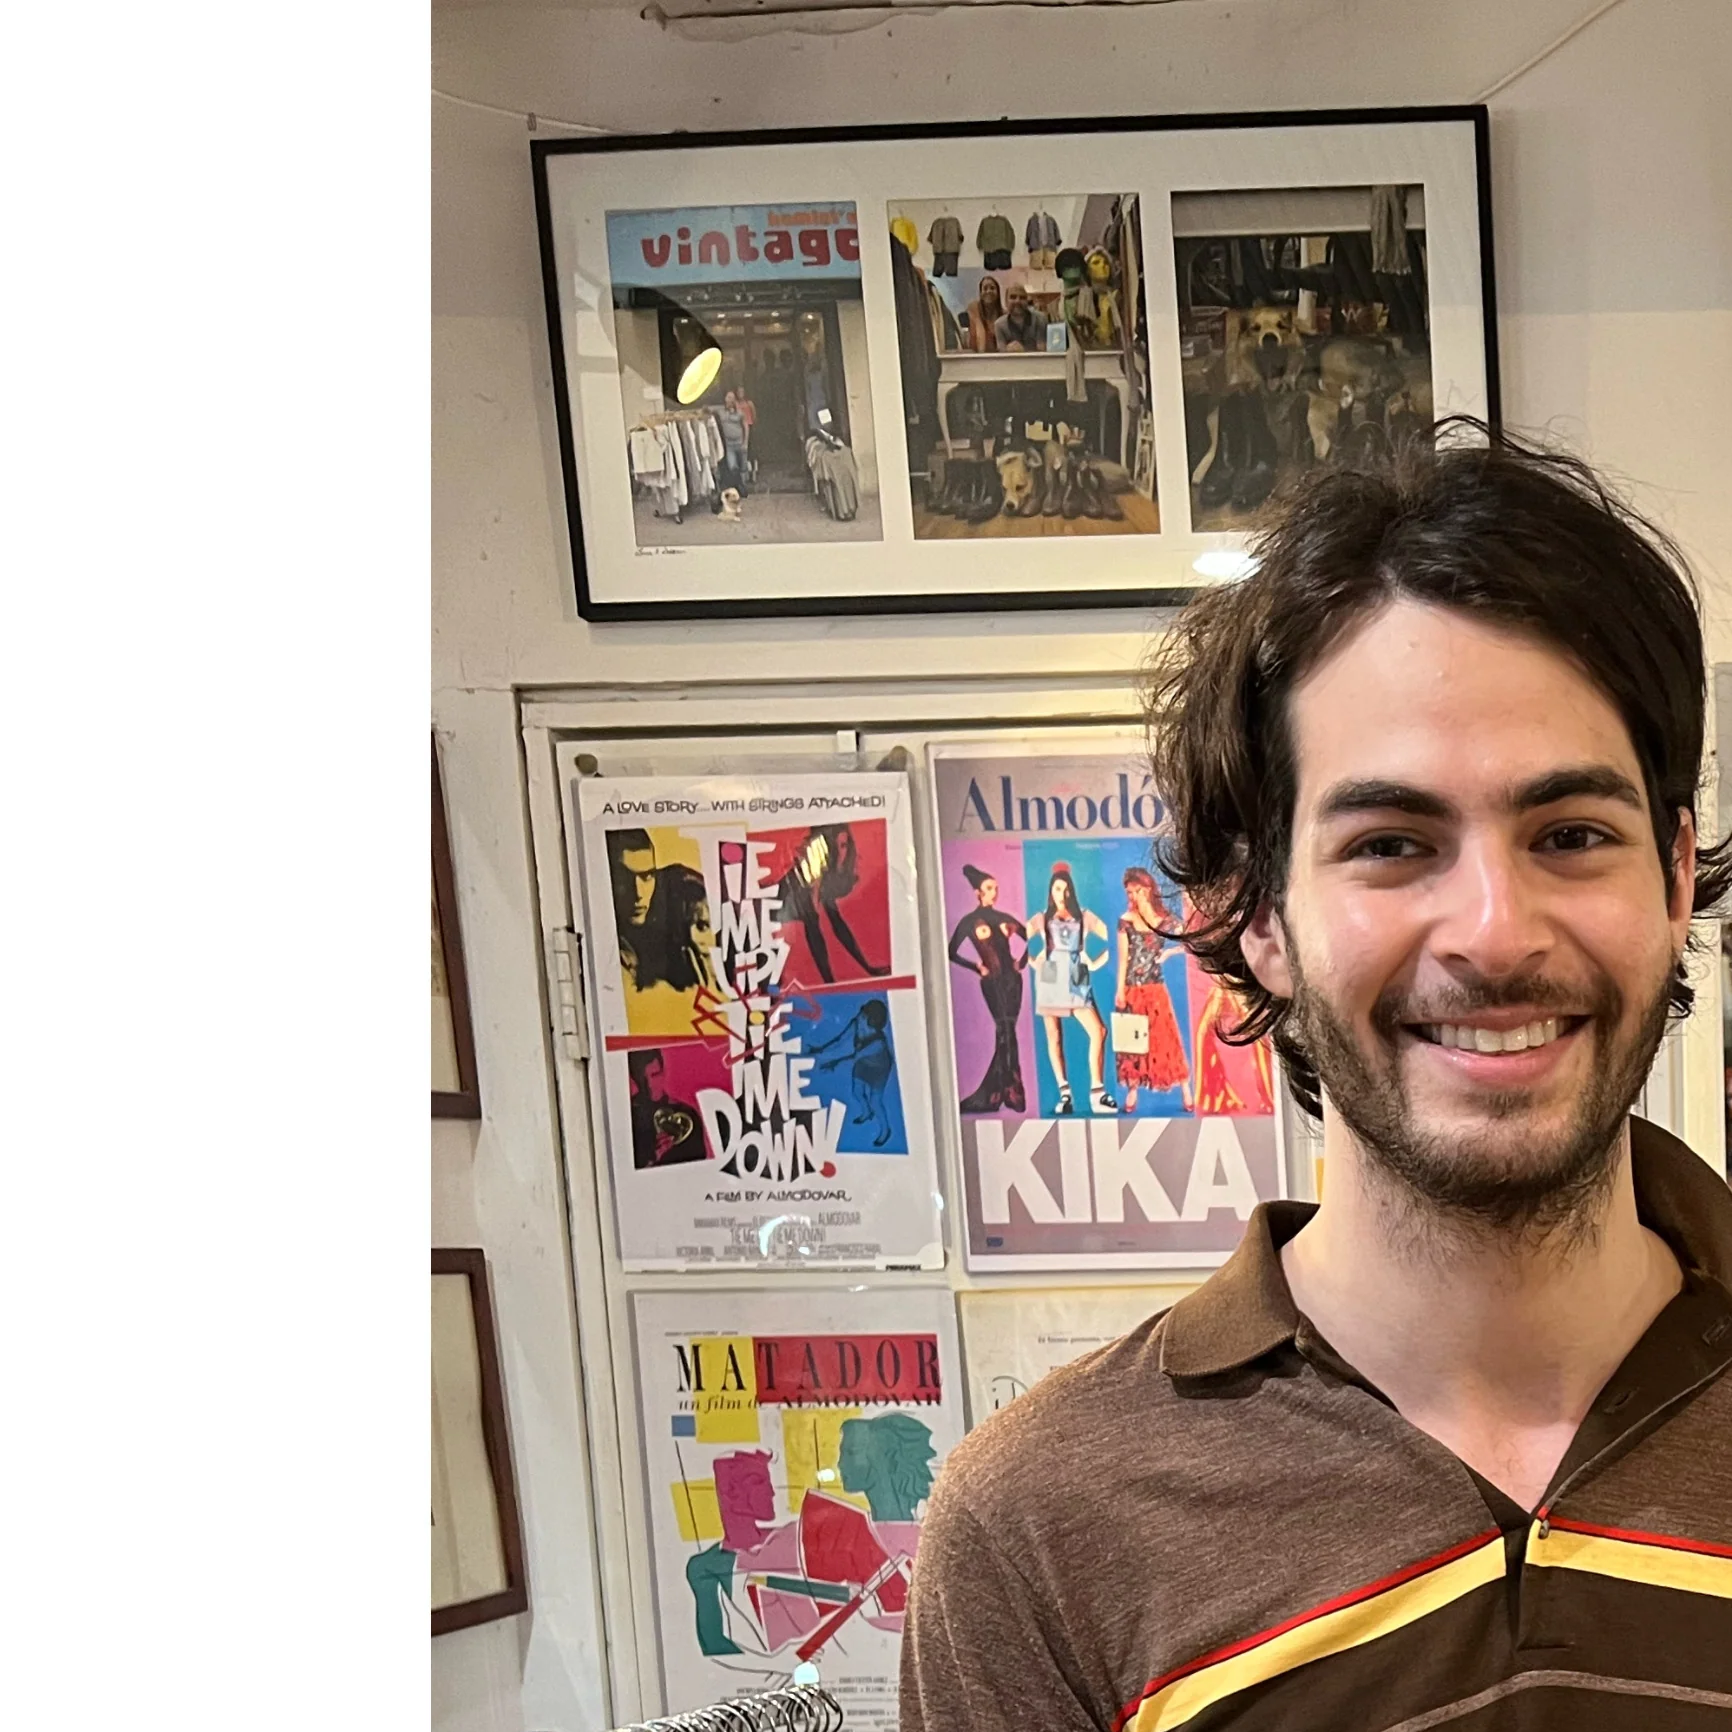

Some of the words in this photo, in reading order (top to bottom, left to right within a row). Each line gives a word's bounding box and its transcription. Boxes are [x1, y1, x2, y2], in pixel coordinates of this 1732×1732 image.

[602, 802, 614, 815] A
[616, 800, 650, 814] LOVE
[748, 798, 804, 814] STRINGS
[721, 898, 785, 963] ME
[744, 1053, 822, 1124] ME
[695, 1088, 847, 1184] DOWN!
[975, 1118, 1261, 1225] KIKA
[673, 1338, 943, 1393] MATADOR
[704, 1394, 741, 1413] film
